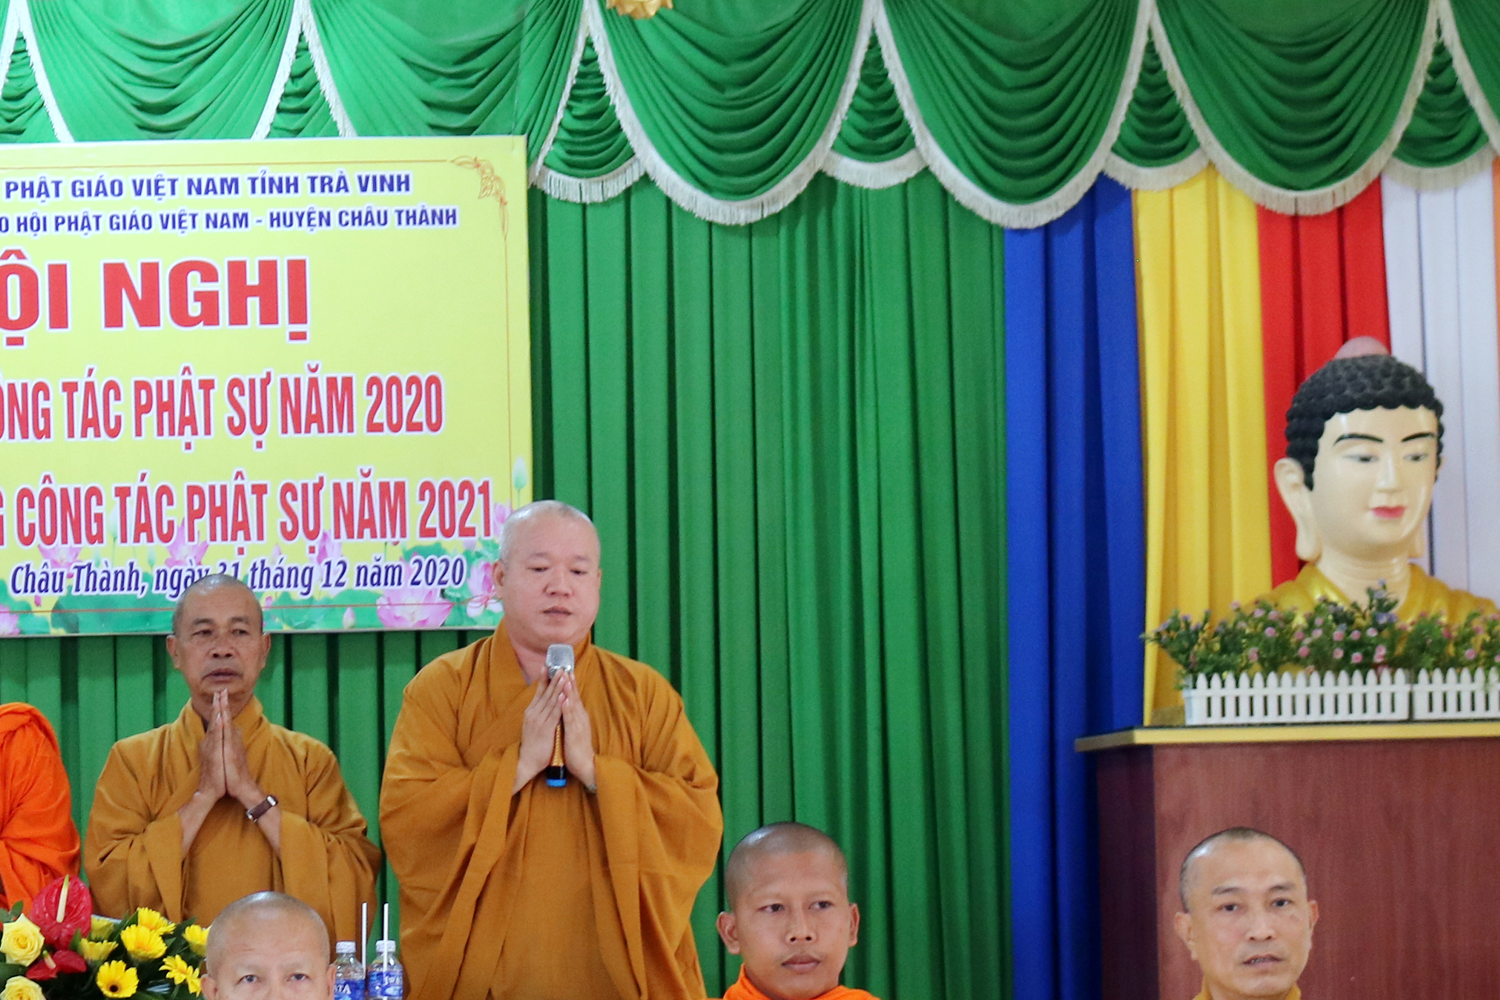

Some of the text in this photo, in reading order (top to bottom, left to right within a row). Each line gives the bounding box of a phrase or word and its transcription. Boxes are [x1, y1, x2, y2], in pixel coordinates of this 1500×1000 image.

[4, 175, 63, 204] PHẬT
[71, 175, 124, 198] GIÁO
[132, 173, 179, 201] VIỆT
[186, 177, 240, 196] NAM
[247, 169, 300, 195] TỈNH
[306, 171, 350, 194] TRÀ
[357, 174, 411, 193] VINH
[16, 212, 47, 237] HỘI
[54, 211, 102, 236] PHẬT
[109, 209, 153, 232] GIÁO
[159, 209, 199, 234] VIỆT
[205, 211, 249, 229] NAM
[269, 207, 331, 232] HUYỆN
[338, 205, 388, 227] CHÂU
[394, 204, 457, 227] THÀNH
[102, 258, 308, 341] NGHỊ
[62, 368, 122, 440] TÁC
[133, 366, 215, 450] PHẬT
[227, 371, 272, 449] SỰ
[280, 363, 354, 434] NĂM
[366, 375, 443, 433] 2020
[16, 474, 104, 546] CÔNG
[114, 473, 174, 544] TÁC
[186, 471, 268, 555] PHẬT
[279, 476, 324, 554] SỰ
[333, 468, 407, 539] NĂM
[418, 480, 492, 539] 2021
[11, 561, 64, 594] Châu
[72, 560, 148, 596] Thành,
[250, 558, 314, 596] tháng
[321, 560, 348, 588] 12
[355, 556, 403, 588] năm
[410, 557, 465, 587] 2020
